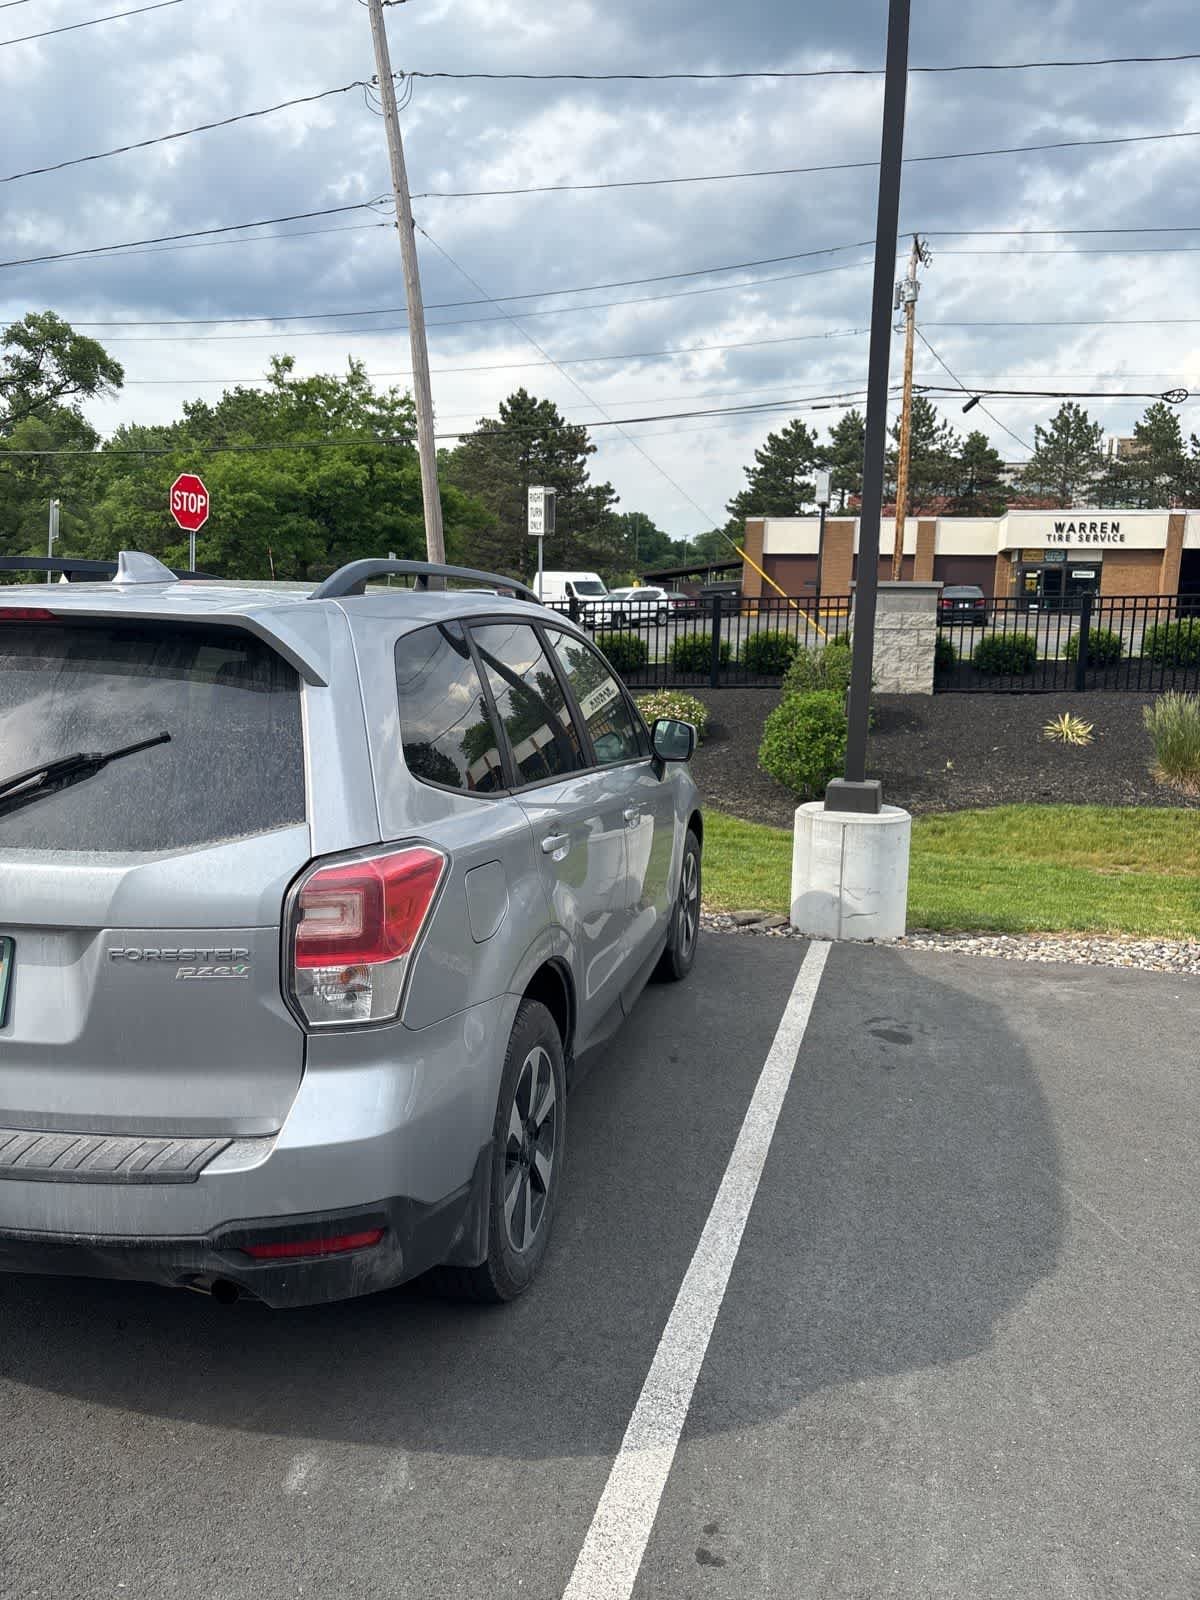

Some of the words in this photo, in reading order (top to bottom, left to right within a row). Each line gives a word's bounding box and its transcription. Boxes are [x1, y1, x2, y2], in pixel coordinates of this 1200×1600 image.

[173, 490, 206, 514] STOP
[529, 492, 543, 502] RIGHT
[530, 507, 543, 518] TURN
[530, 521, 542, 530] ONLY
[1054, 522, 1120, 533] WARREN
[1047, 534, 1071, 542] TIRE
[1078, 534, 1125, 542] SERVICE
[108, 947, 249, 960] FORESTER
